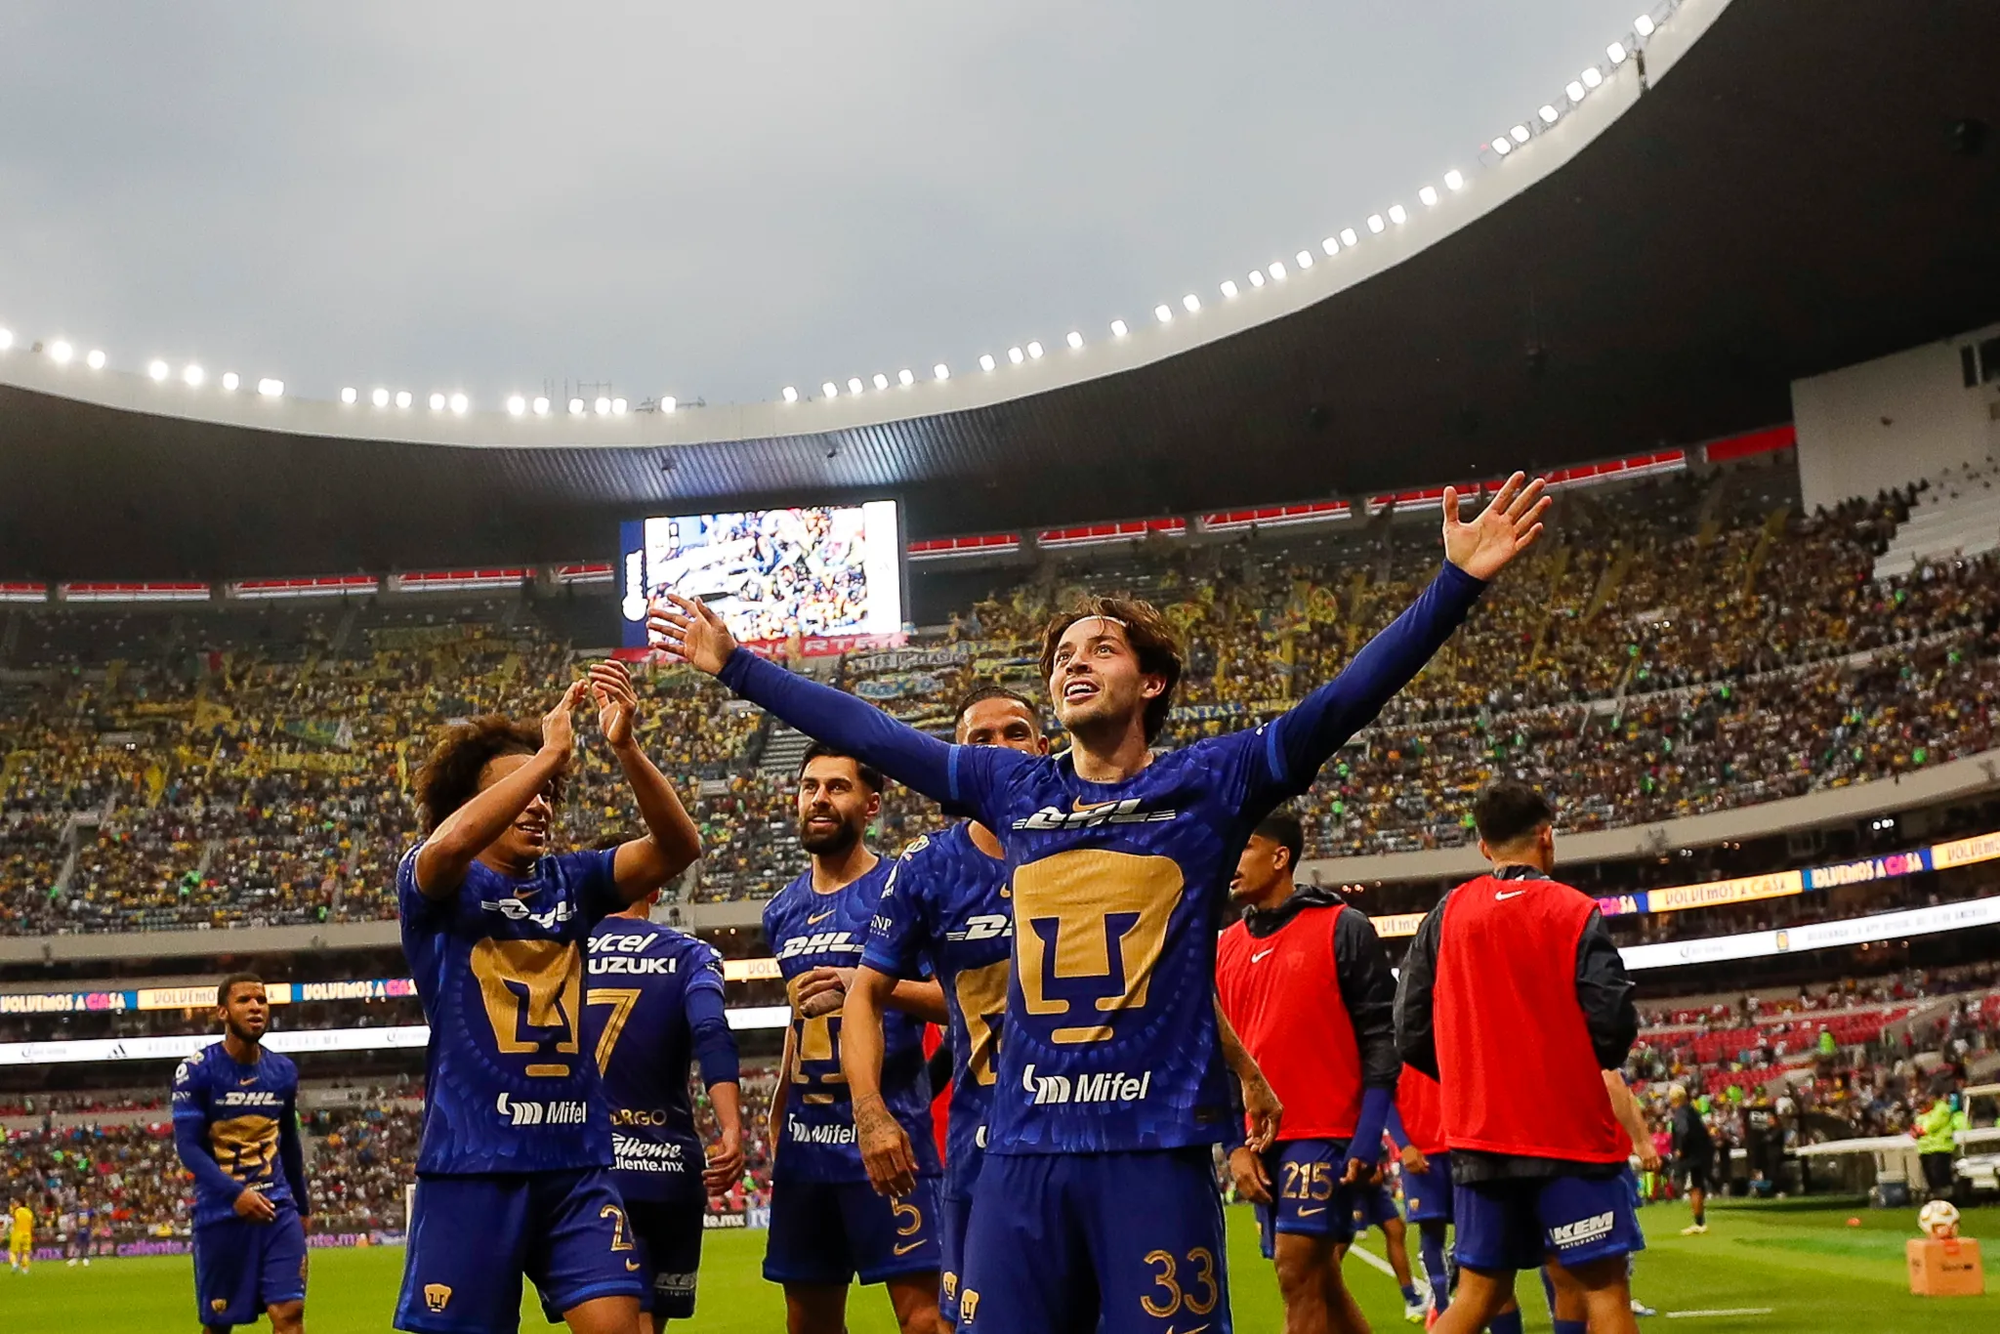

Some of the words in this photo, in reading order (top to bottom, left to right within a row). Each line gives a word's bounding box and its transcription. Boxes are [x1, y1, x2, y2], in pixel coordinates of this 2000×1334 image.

[1022, 798, 1150, 830] DHL
[780, 932, 853, 959] DHL
[588, 956, 676, 974] UZUKI
[587, 988, 642, 1079] 7
[224, 1091, 277, 1106] DHL
[1074, 1070, 1151, 1103] Mifel
[546, 1101, 587, 1124] Mifel
[811, 1124, 857, 1144] Mifel
[609, 1156, 685, 1173] liente.mx
[1281, 1160, 1333, 1200] 215
[600, 1204, 634, 1251] 2
[889, 1195, 922, 1236] 5
[1553, 1210, 1614, 1240] KEM
[1140, 1247, 1218, 1318] 33
